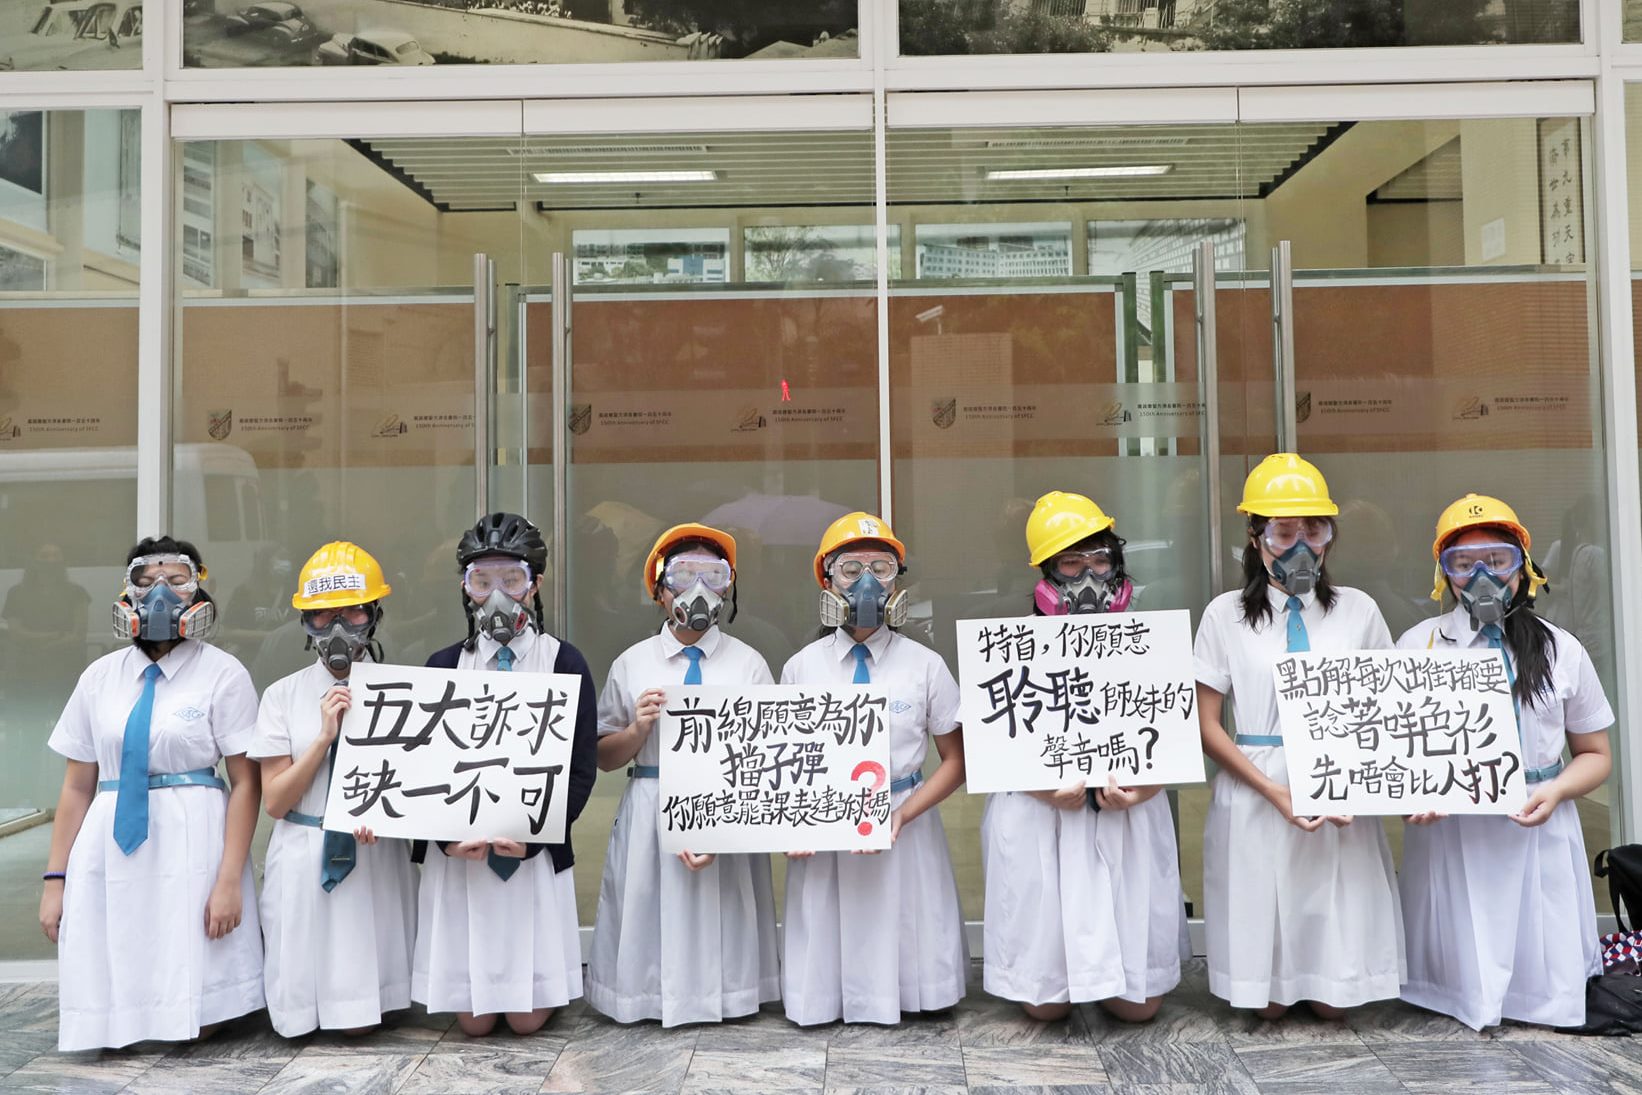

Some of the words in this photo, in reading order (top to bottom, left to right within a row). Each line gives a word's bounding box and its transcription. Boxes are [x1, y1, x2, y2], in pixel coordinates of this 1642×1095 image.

[308, 574, 361, 594] 還我民主
[977, 665, 1194, 739] 聆聽師妹的
[1276, 656, 1510, 701] 點解每次出街都要
[345, 680, 569, 756] 五大訴求
[666, 692, 887, 754] 前線願意為你
[342, 757, 564, 836] 缺一不可
[719, 741, 829, 791] 擋子彈
